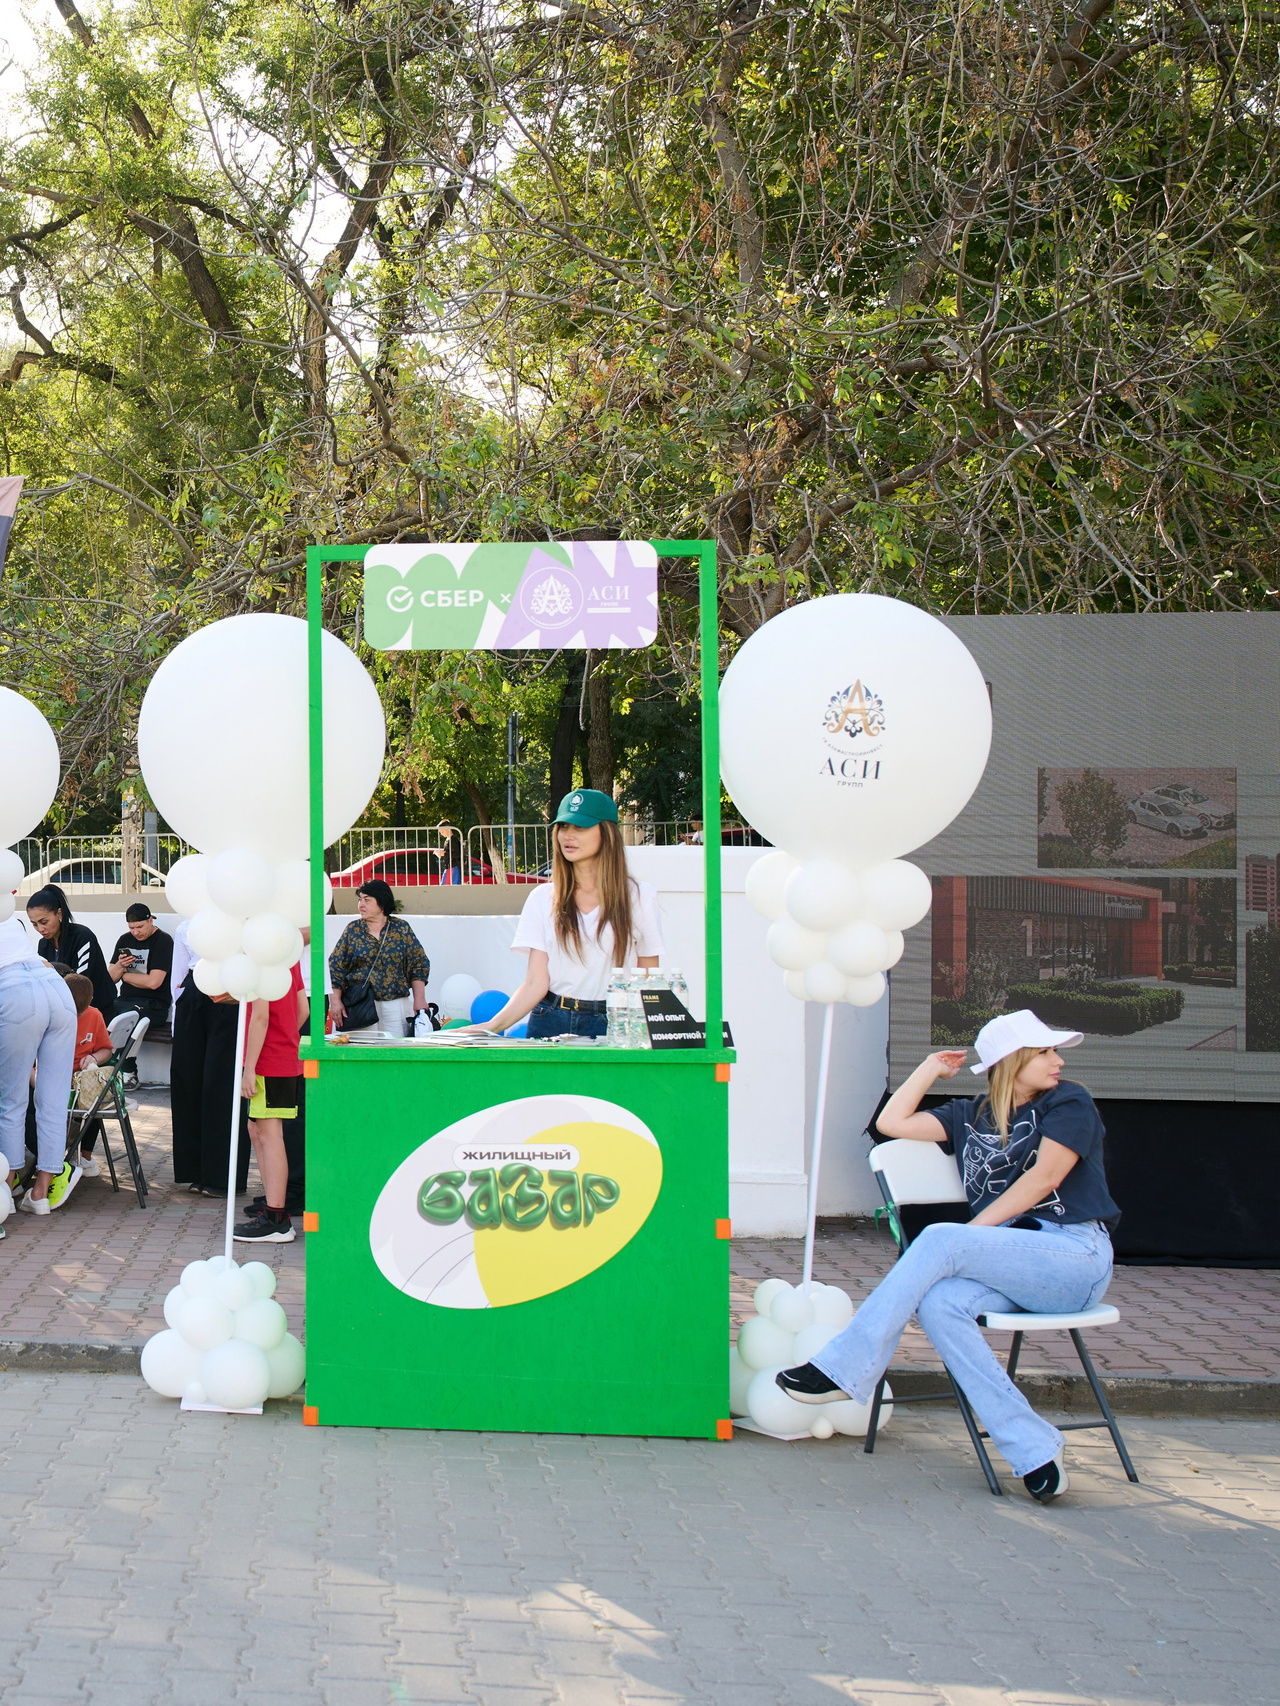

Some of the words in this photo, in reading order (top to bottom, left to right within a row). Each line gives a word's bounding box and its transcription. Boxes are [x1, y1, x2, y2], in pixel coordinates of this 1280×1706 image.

[420, 590, 484, 607] СБЕР
[587, 585, 630, 601] АСИ
[819, 757, 882, 780] АСИ
[837, 780, 864, 788] ГРУПП
[648, 1013, 664, 1022] МОЙ
[652, 1031, 701, 1041] КОМФОРТНОЙ
[463, 1150, 571, 1161] ЖИЛИЩНЫЙ
